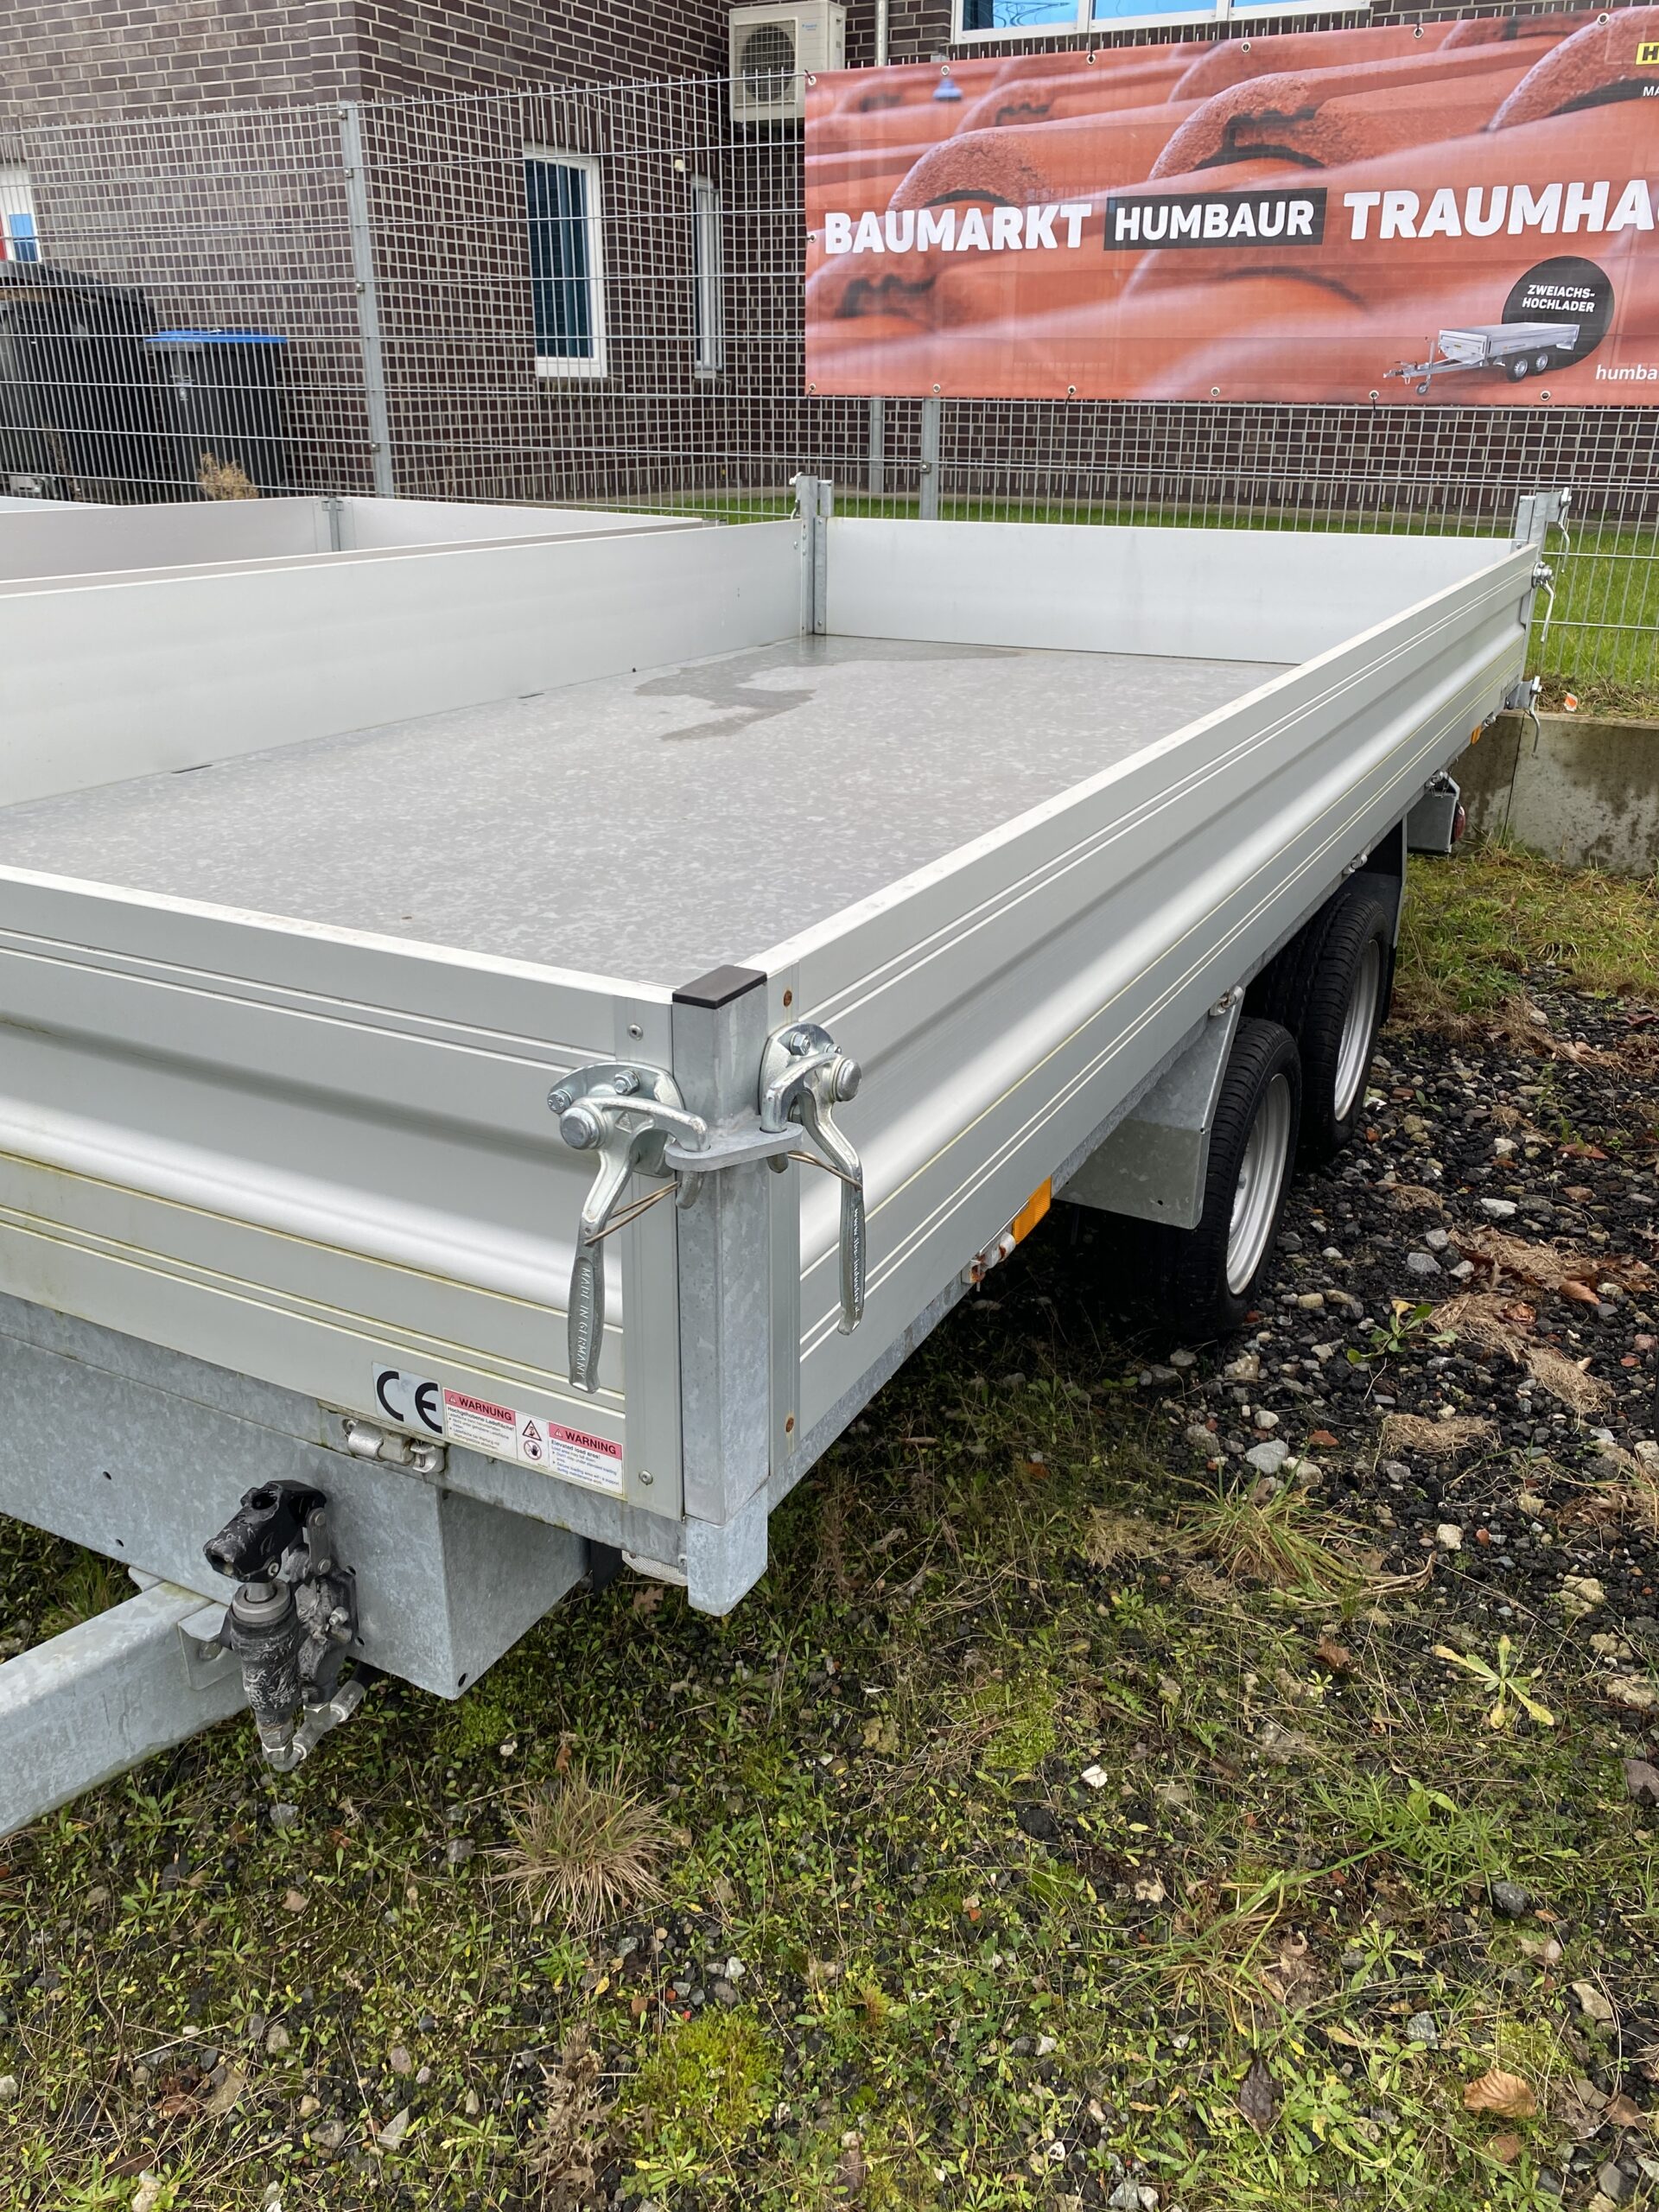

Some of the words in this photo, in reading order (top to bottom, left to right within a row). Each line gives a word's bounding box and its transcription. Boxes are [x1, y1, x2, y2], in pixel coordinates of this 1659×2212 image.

[1642, 46, 1659, 61] H
[824, 203, 1092, 254] BAUMARKT
[1114, 200, 1315, 241] HUMBAUR
[1344, 180, 1659, 240] TRAUMHA
[1527, 284, 1596, 299] ZWEIACHS-
[1522, 297, 1596, 313] HOCHLADER
[1595, 364, 1659, 380] humba
[579, 1305, 590, 1319] IN
[459, 1396, 512, 1422] WARNUNG
[565, 1430, 616, 1455] WARNING
